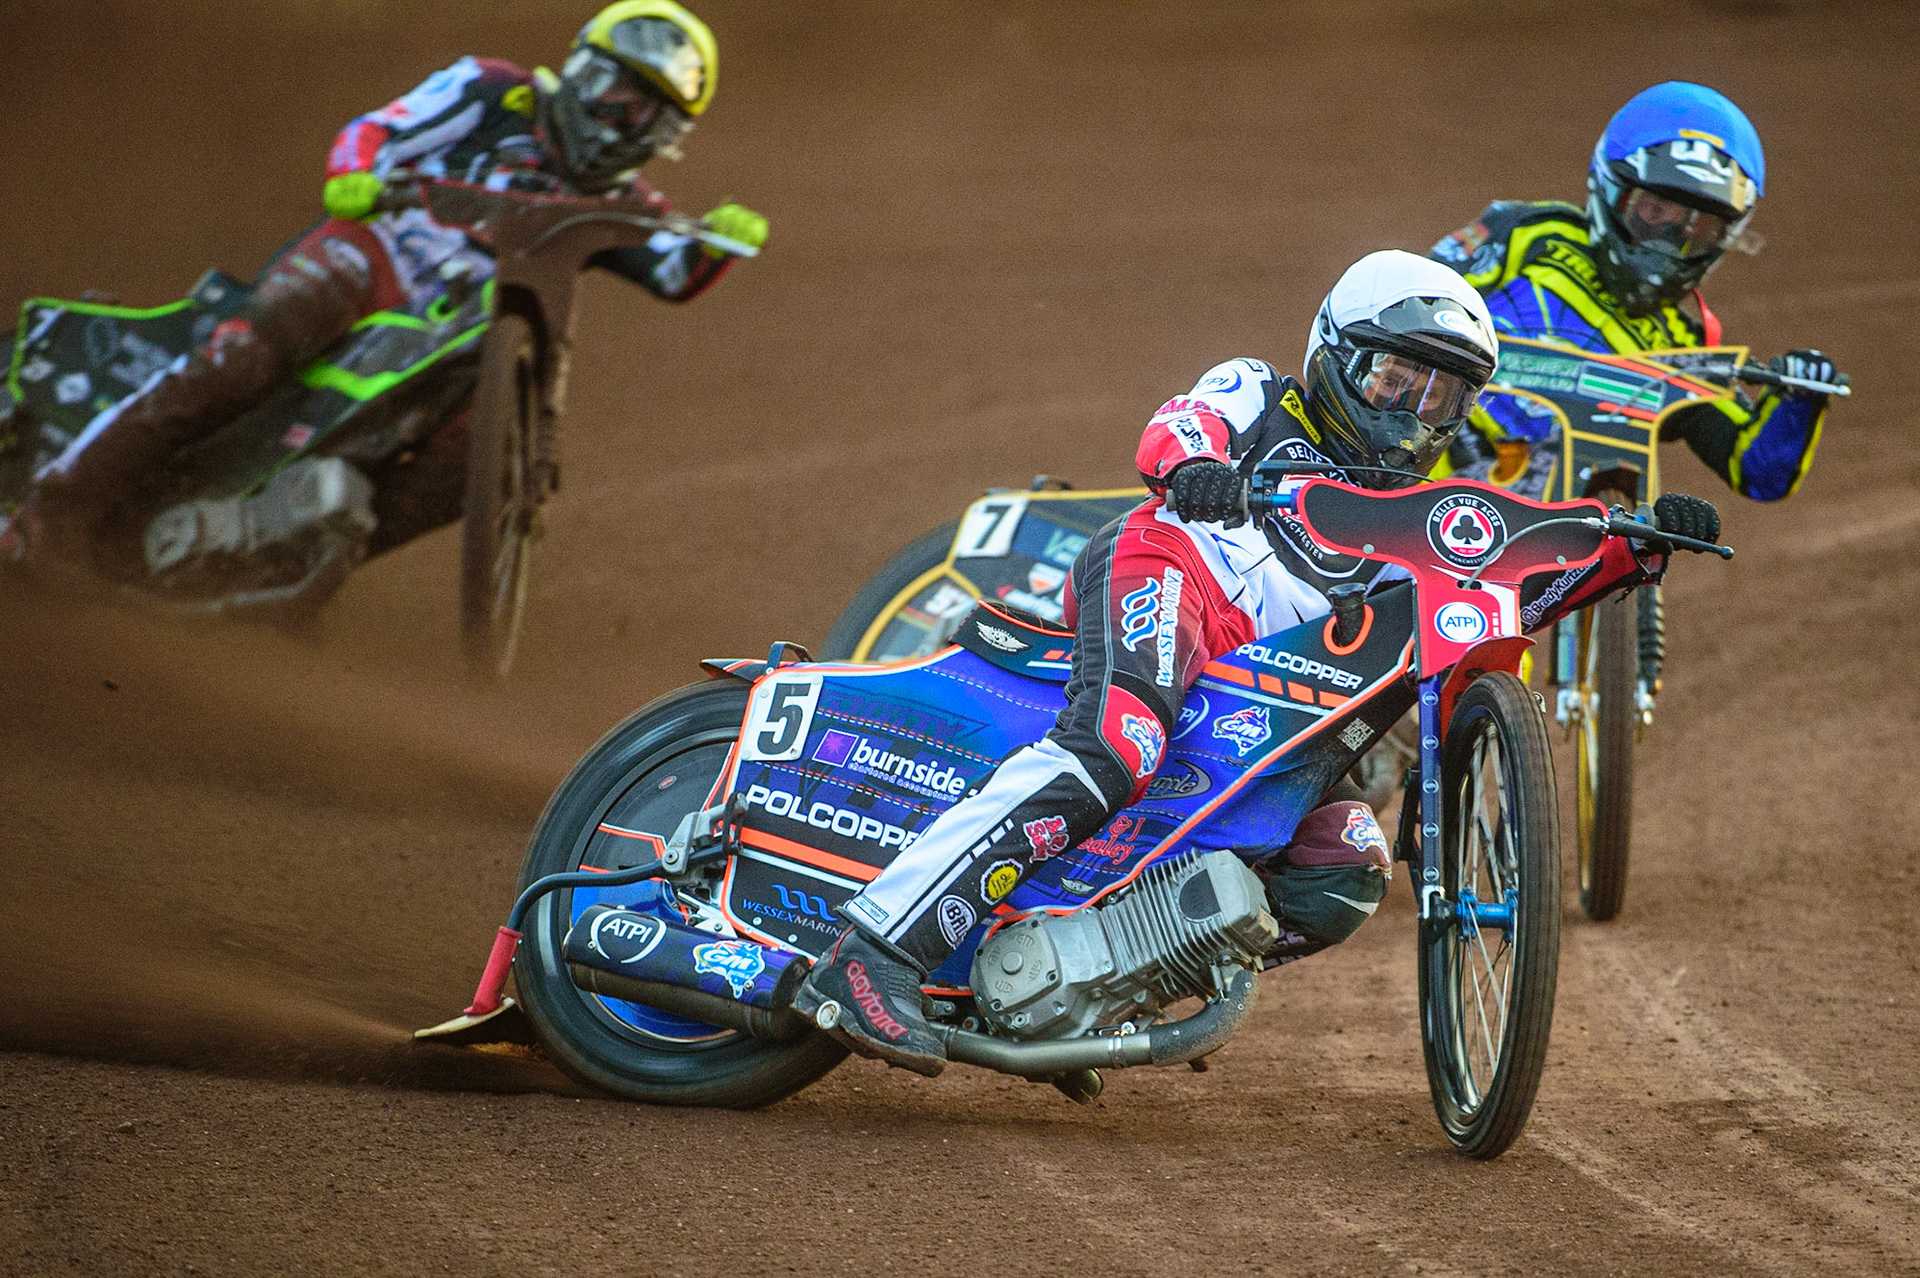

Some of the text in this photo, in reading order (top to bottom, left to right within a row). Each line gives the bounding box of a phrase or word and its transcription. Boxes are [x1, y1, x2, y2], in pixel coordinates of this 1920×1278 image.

[974, 504, 1013, 550] 7
[1432, 497, 1500, 527] BELLE VUE ACES
[1278, 513, 1324, 561] NCHESTER
[1445, 617, 1477, 628] ATPI
[1235, 643, 1363, 690] POLCOPPER
[755, 682, 812, 756] 5
[1221, 720, 1262, 738] GM
[852, 738, 966, 795] burnside
[747, 784, 920, 850] POLCOPPE
[1077, 834, 1135, 865] ealey
[601, 918, 653, 944] ATPI
[742, 899, 844, 938] WESSEXMARIN
[703, 949, 754, 970] GM
